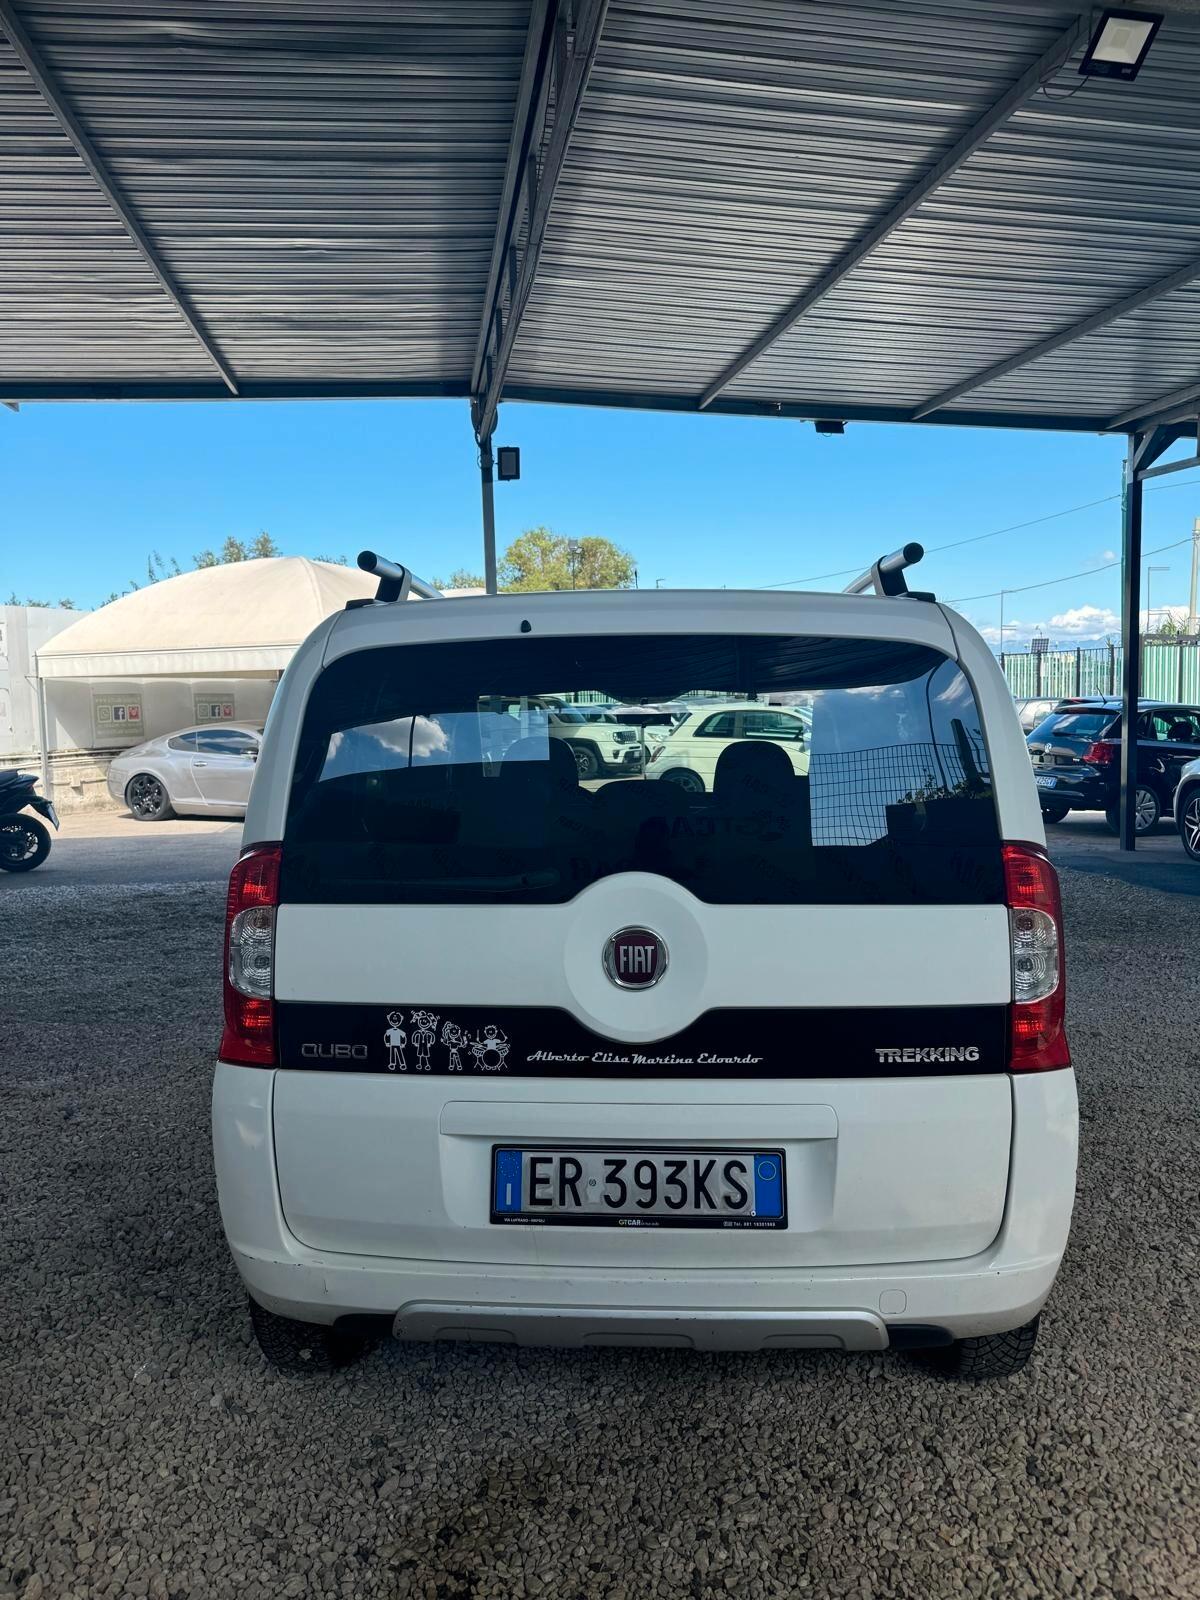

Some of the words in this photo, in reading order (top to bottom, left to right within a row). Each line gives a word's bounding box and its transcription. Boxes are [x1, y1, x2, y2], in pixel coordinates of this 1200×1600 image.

[619, 945, 655, 974] FIAT
[301, 1043, 368, 1059] QUBO
[526, 1050, 590, 1062] Alberto
[591, 1051, 630, 1063] Elisa
[631, 1053, 694, 1065] Martina
[696, 1052, 763, 1064] Edoardo
[874, 1046, 980, 1063] TREKKING
